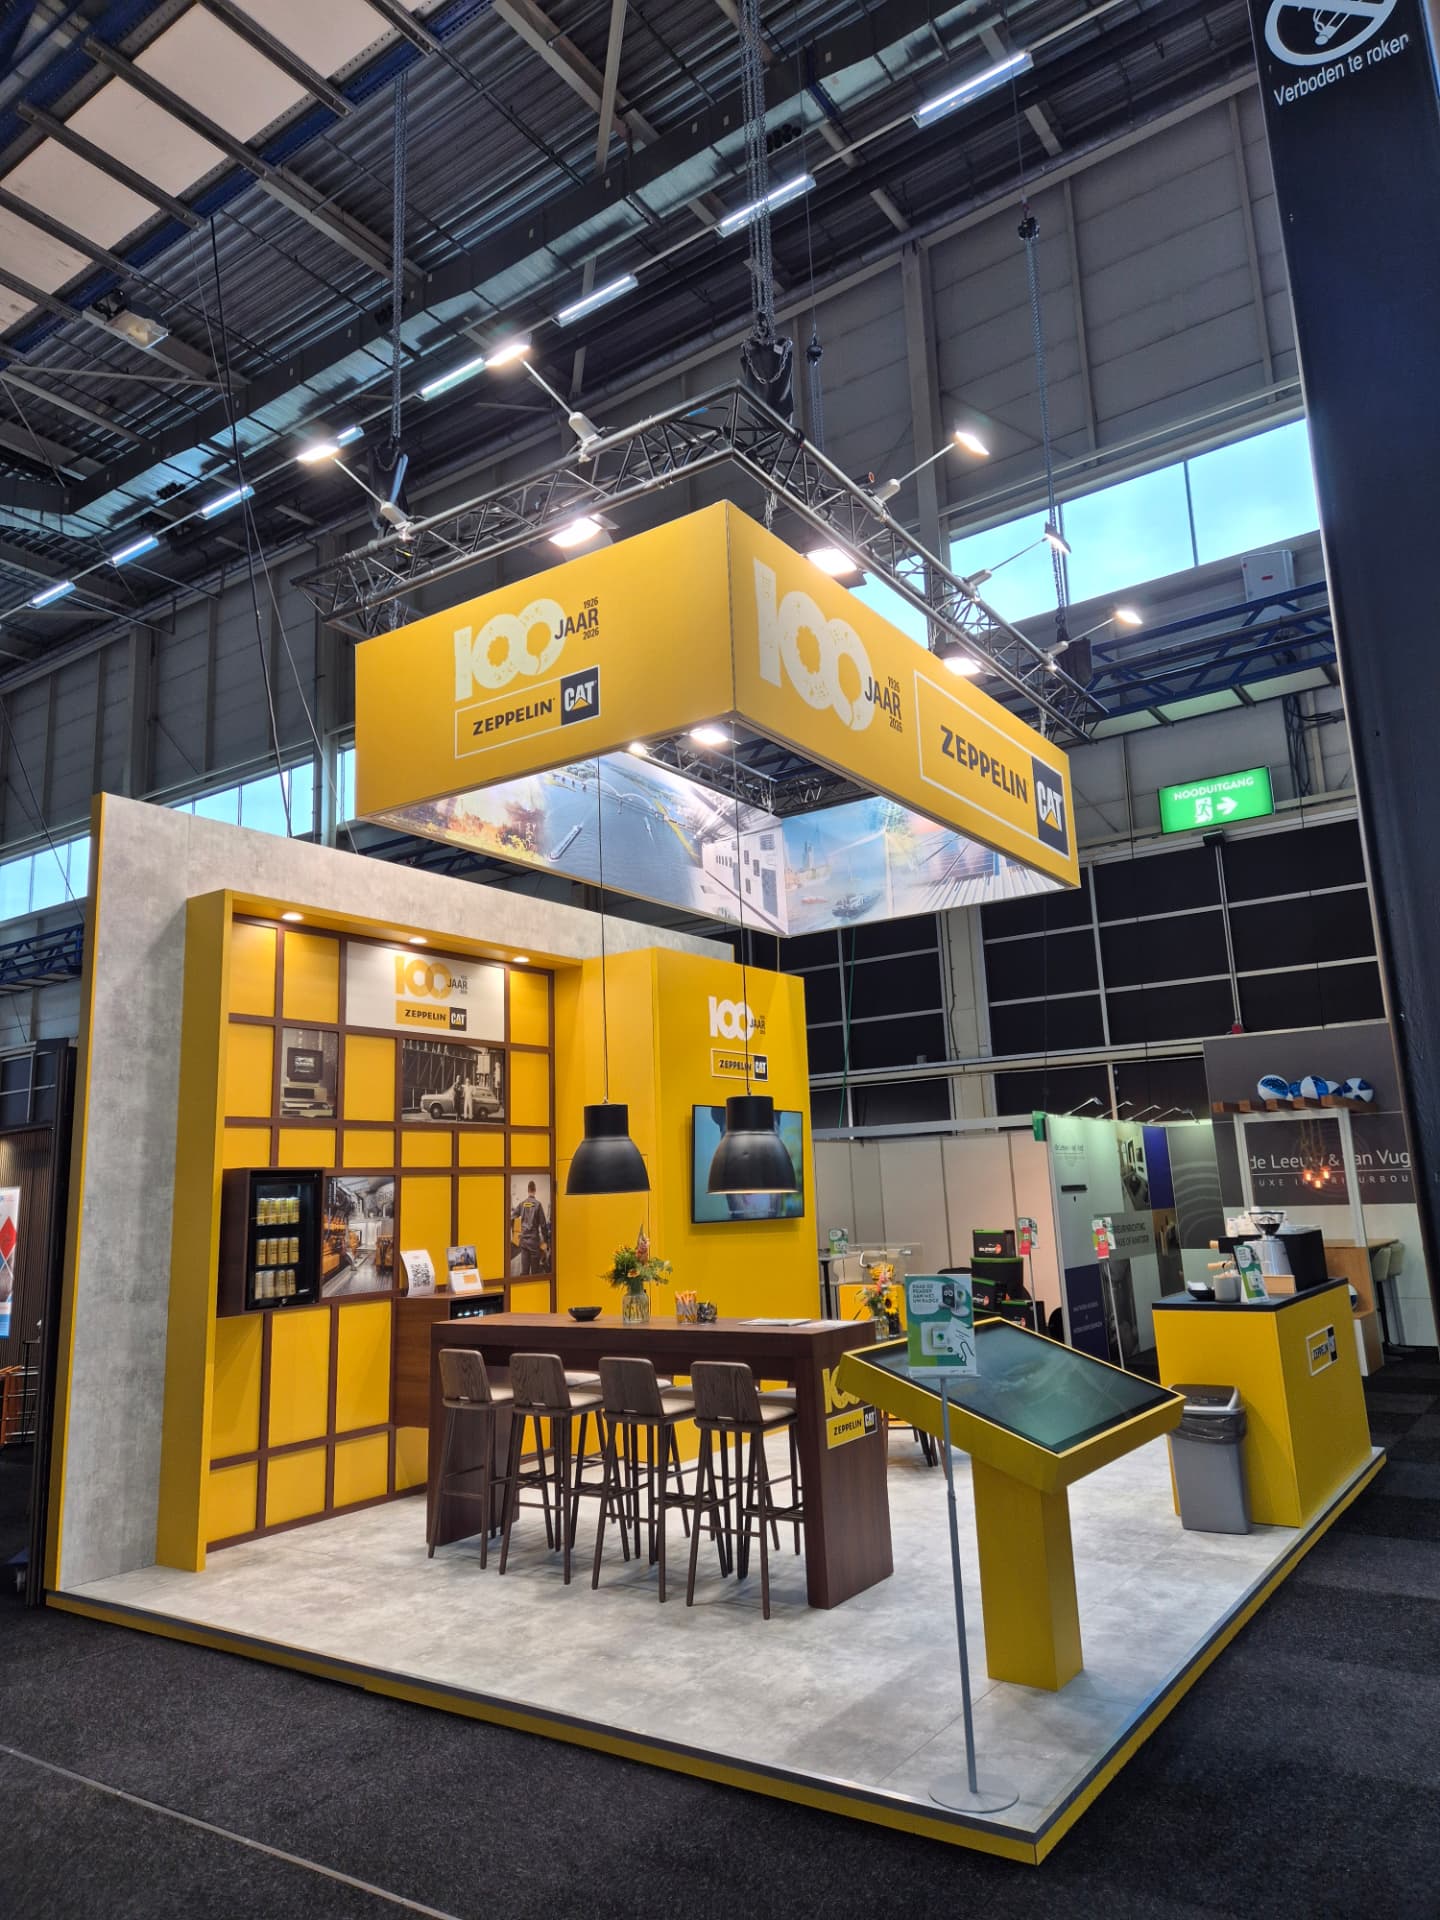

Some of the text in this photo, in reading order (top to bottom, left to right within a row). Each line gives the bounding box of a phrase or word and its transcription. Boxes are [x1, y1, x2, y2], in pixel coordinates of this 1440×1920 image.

[1273, 33, 1409, 106] Verboden te roken
[584, 597, 599, 609] 1926
[453, 598, 599, 703] 100 JAAR
[583, 627, 600, 640] 2026
[753, 558, 902, 731] 100 JAAR
[472, 681, 596, 737] ZEPPELIN CAT
[940, 724, 1064, 831] ZEPPELIN CAT
[1173, 776, 1255, 801] NOODUITGANG
[395, 955, 468, 1000] 100 JAAR
[404, 1008, 466, 1025] ZEPPELIN CAT
[708, 995, 755, 1041] 100
[1258, 1178, 1284, 1187] UXE
[1328, 1153, 1340, 1167] &
[822, 1365, 860, 1414] 10
[833, 1411, 875, 1436] ZEPPELIN CAT
